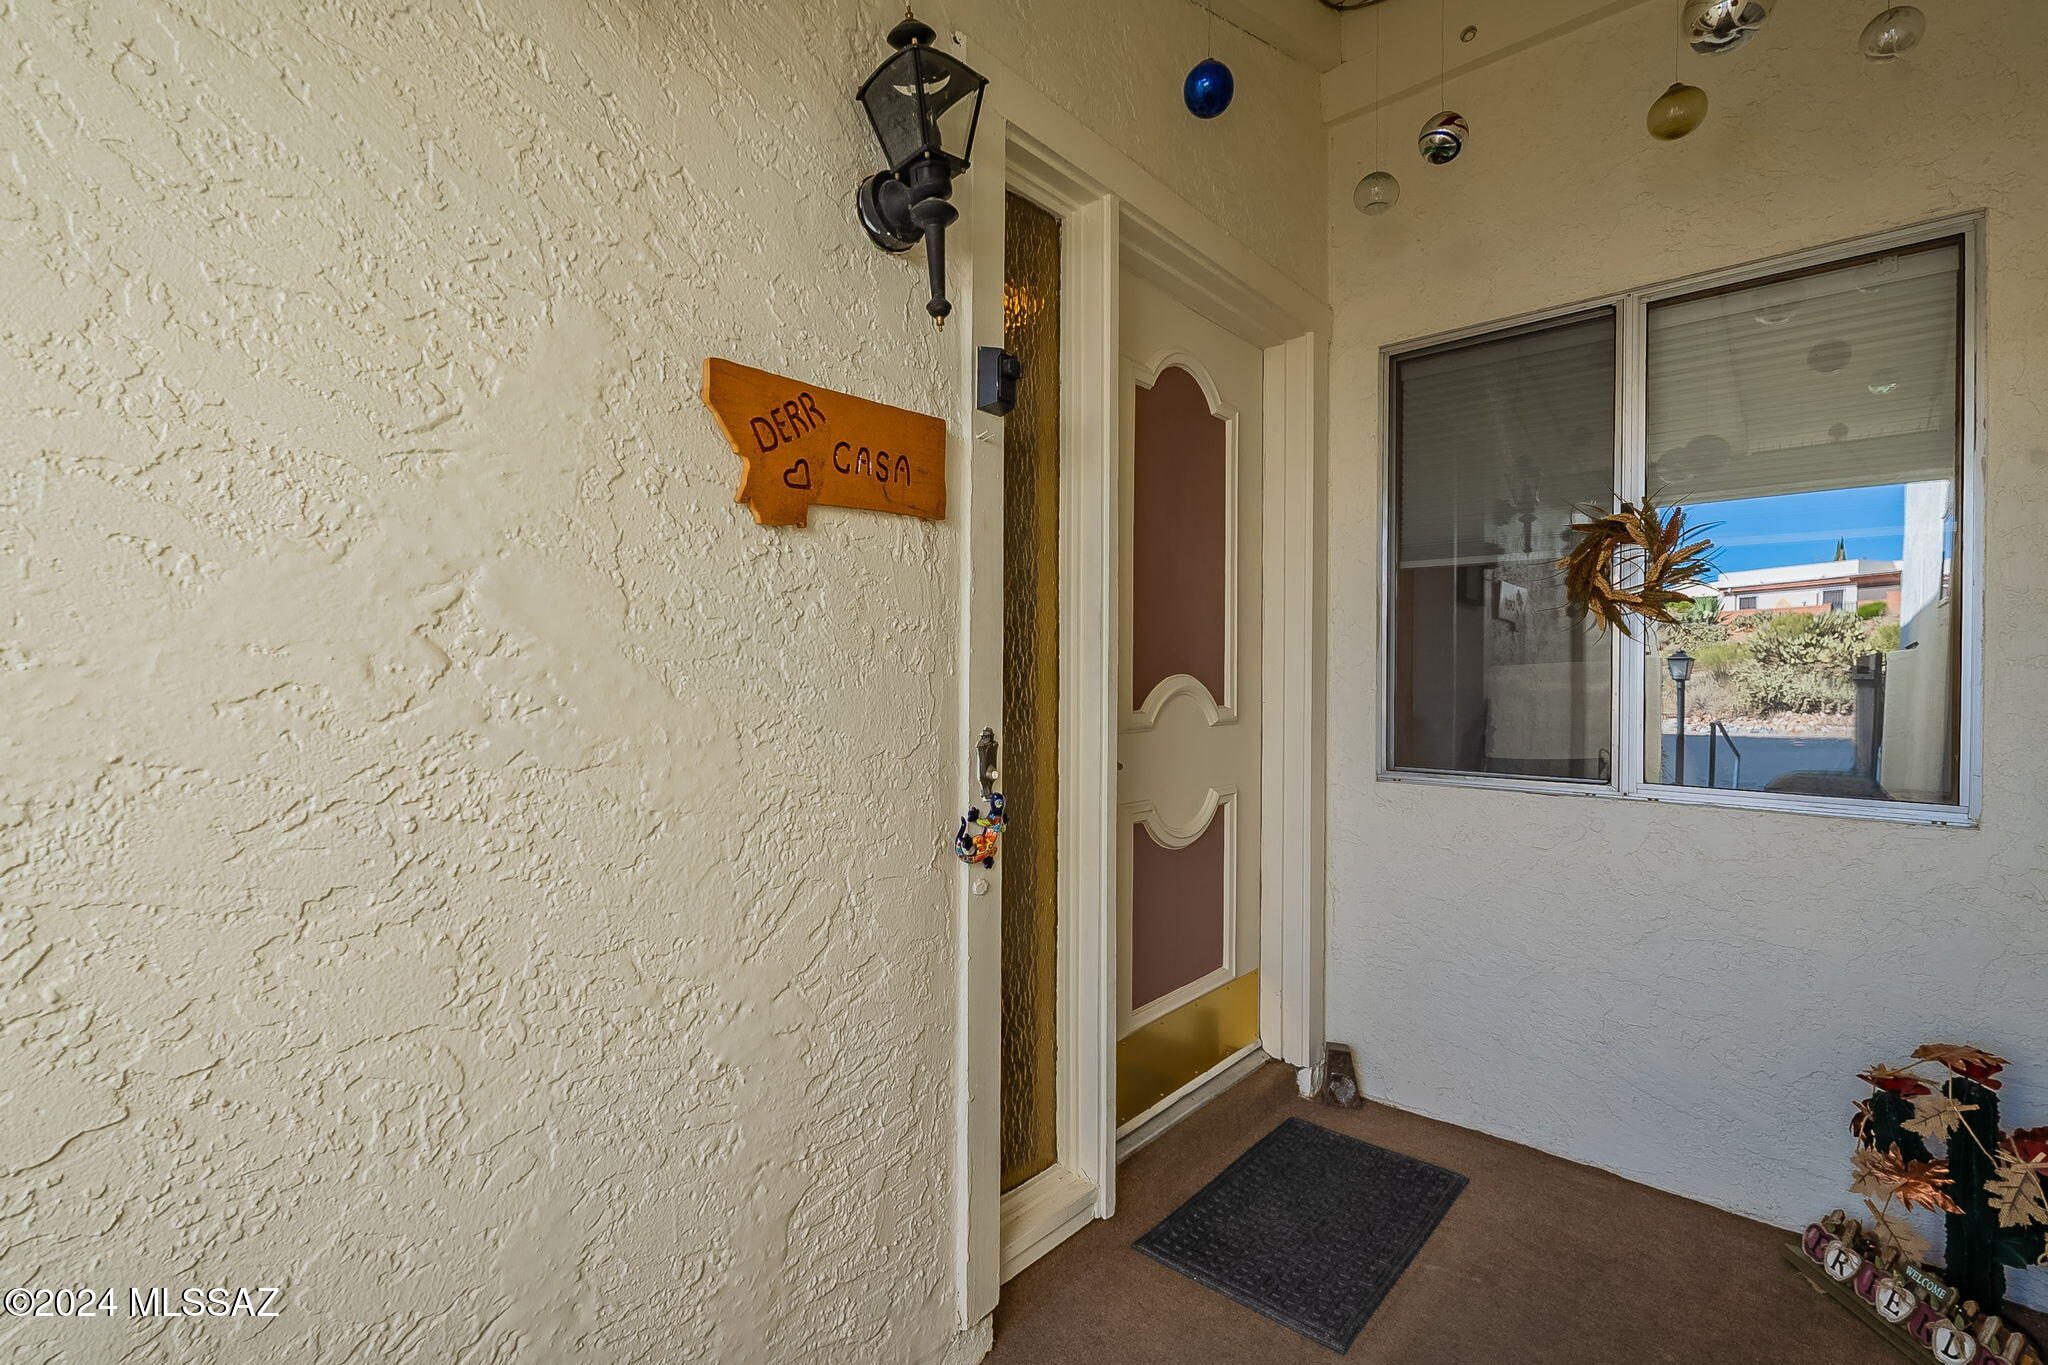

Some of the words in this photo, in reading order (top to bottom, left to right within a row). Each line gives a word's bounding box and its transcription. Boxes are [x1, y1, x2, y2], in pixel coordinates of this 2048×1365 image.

[750, 392, 826, 453] DERR
[833, 441, 911, 486] CASA
[1905, 1265, 1948, 1299] WELCOME
